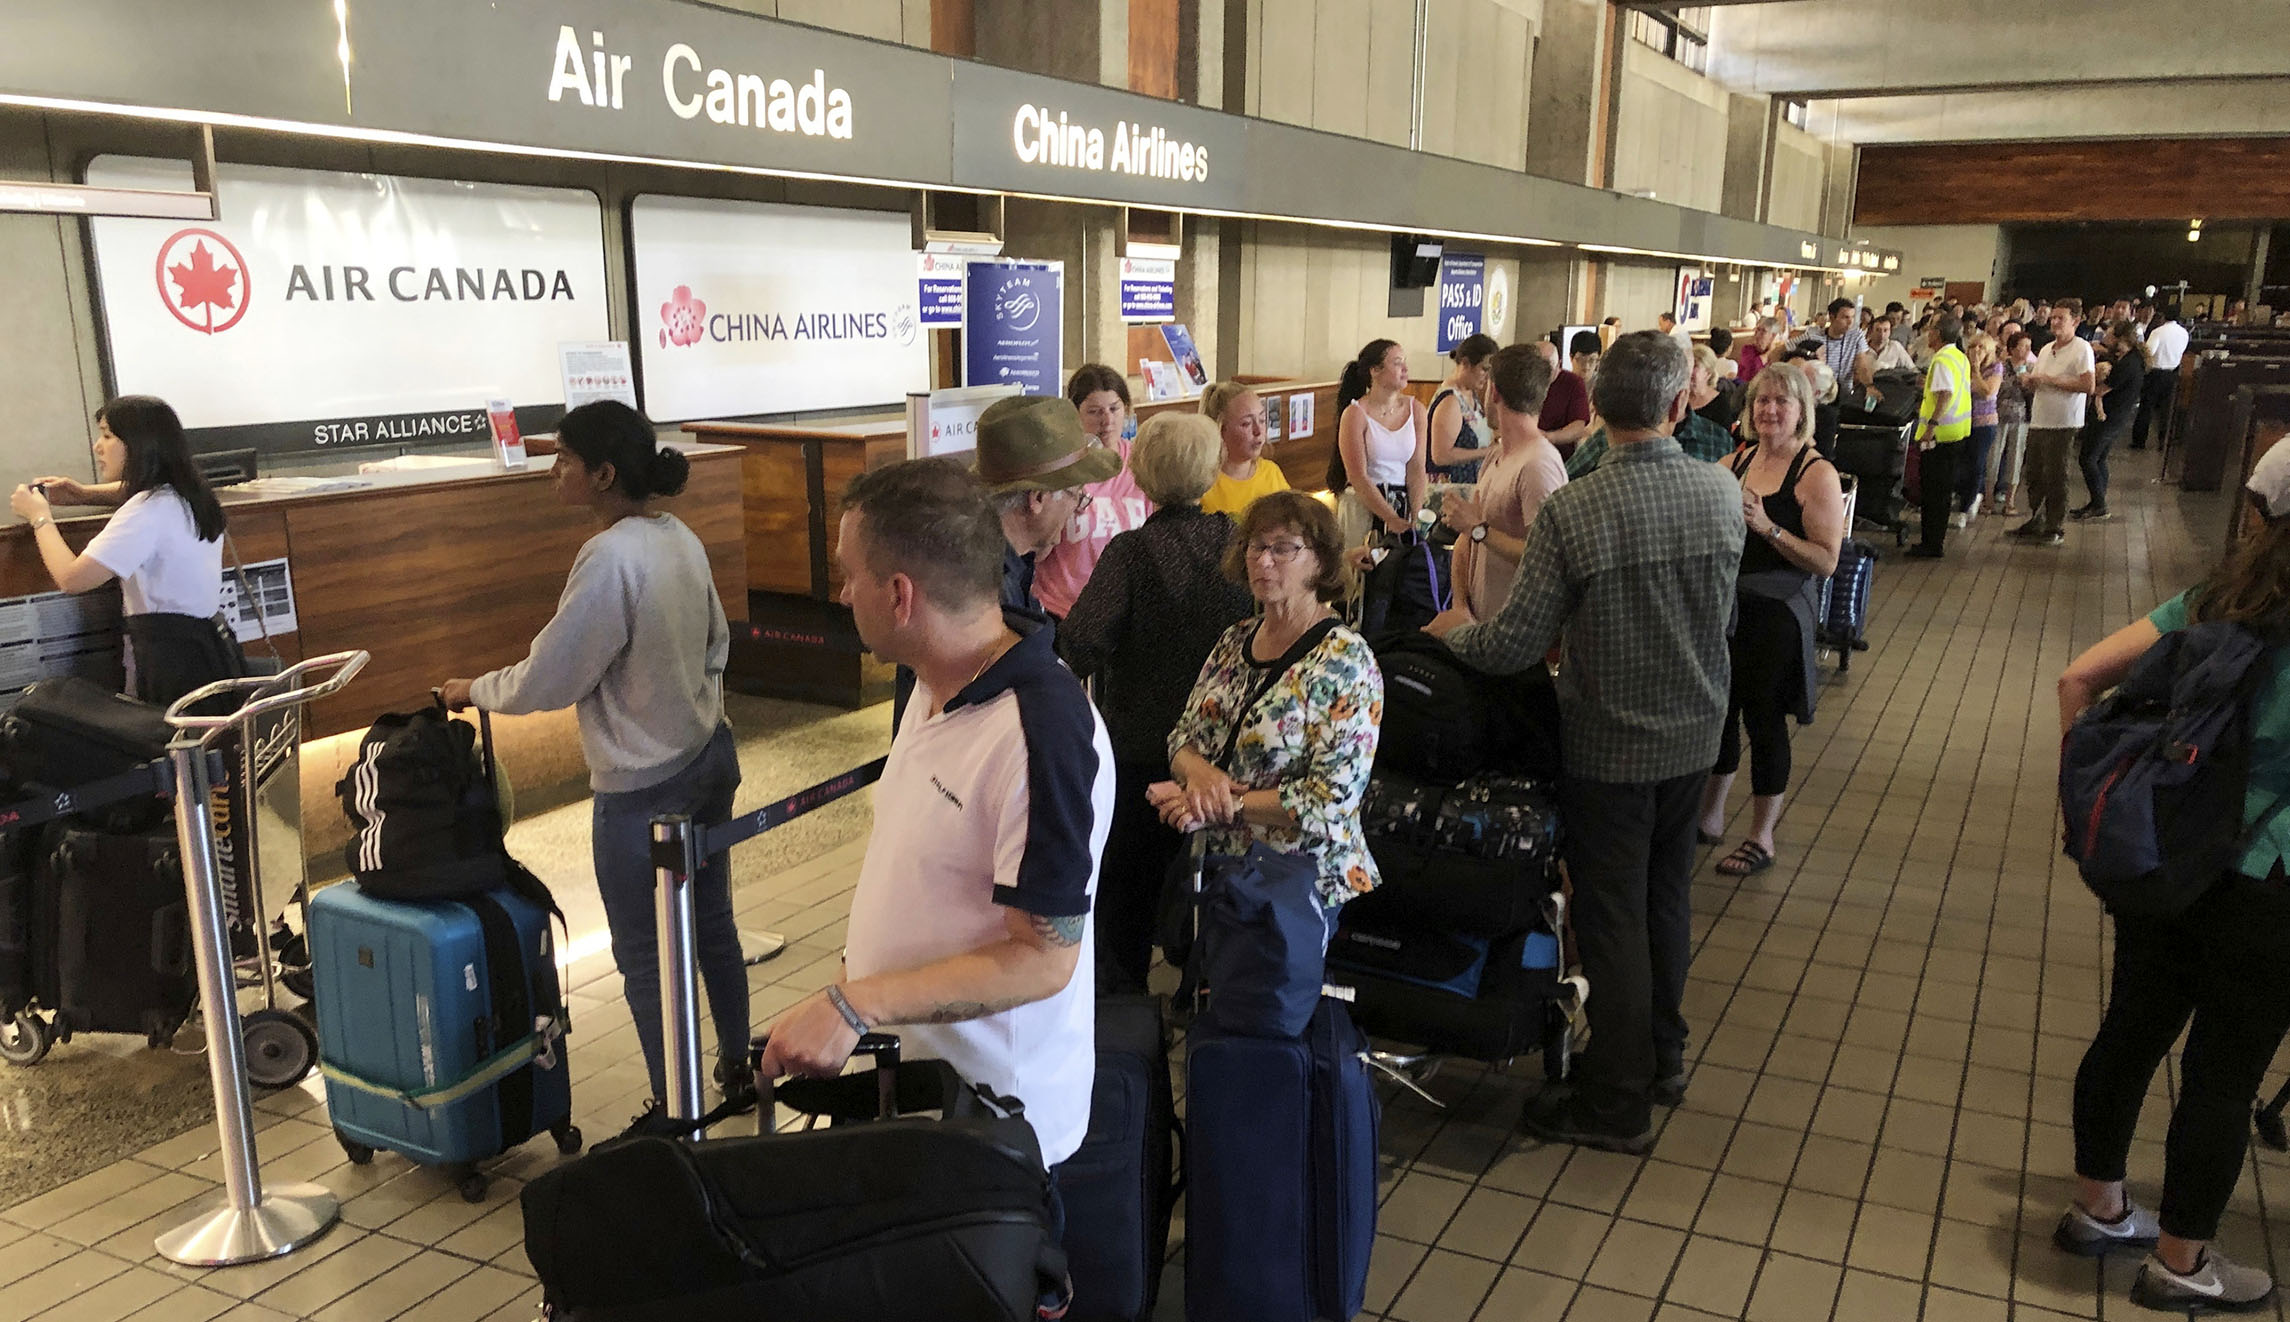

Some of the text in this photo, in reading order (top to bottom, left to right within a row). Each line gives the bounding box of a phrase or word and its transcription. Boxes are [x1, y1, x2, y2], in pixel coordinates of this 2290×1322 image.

[548, 25, 852, 140] Air Canada
[1013, 104, 1208, 183] China Airlines
[286, 265, 575, 302] AIR CANADA
[994, 277, 1032, 321] SKYTEAM
[1442, 283, 1482, 308] PASS & ID
[709, 312, 788, 343] CHINA
[794, 312, 887, 340] AIRLINES
[1447, 314, 1474, 341] Office
[314, 414, 473, 445] STAR ALLIANCE
[945, 423, 964, 437] AIR
[782, 630, 825, 645] CANADA
